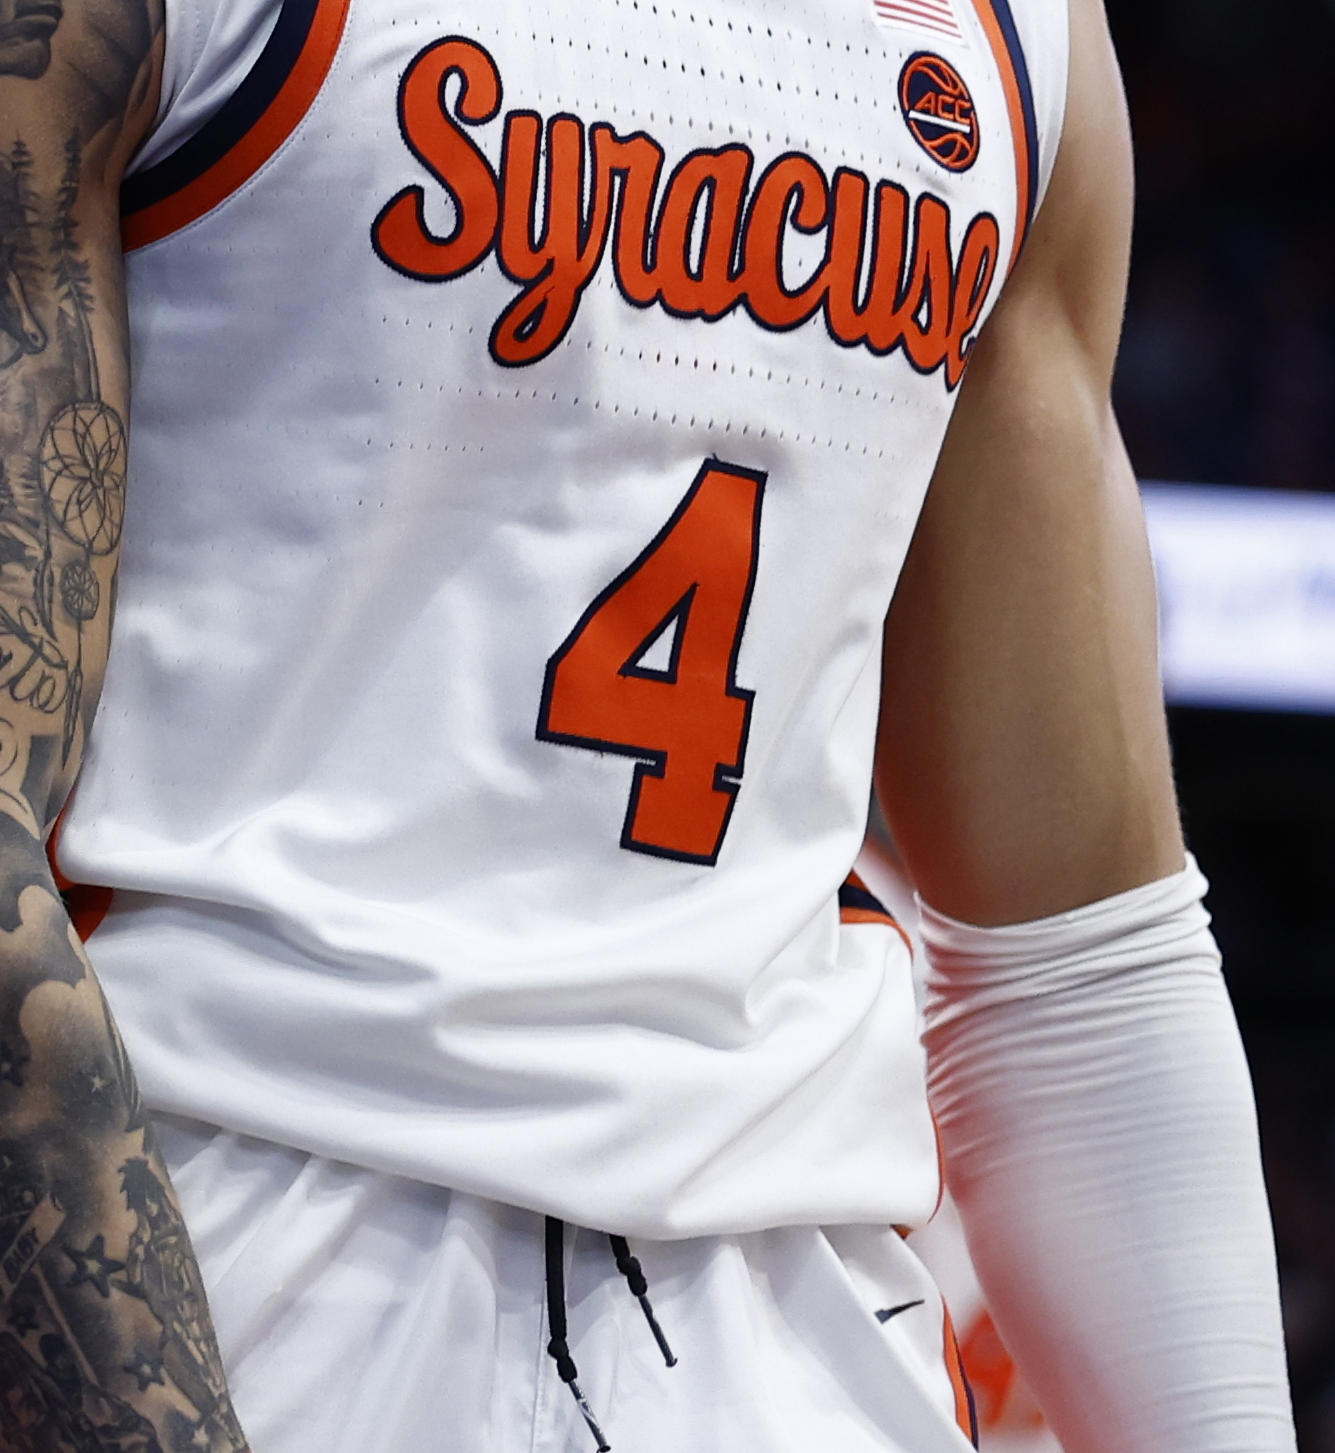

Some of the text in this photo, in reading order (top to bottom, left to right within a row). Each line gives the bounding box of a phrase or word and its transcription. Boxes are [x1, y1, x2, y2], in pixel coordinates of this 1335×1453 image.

[372, 35, 1001, 393] Syracuse
[914, 91, 972, 125] ACC
[534, 454, 769, 868] 4
